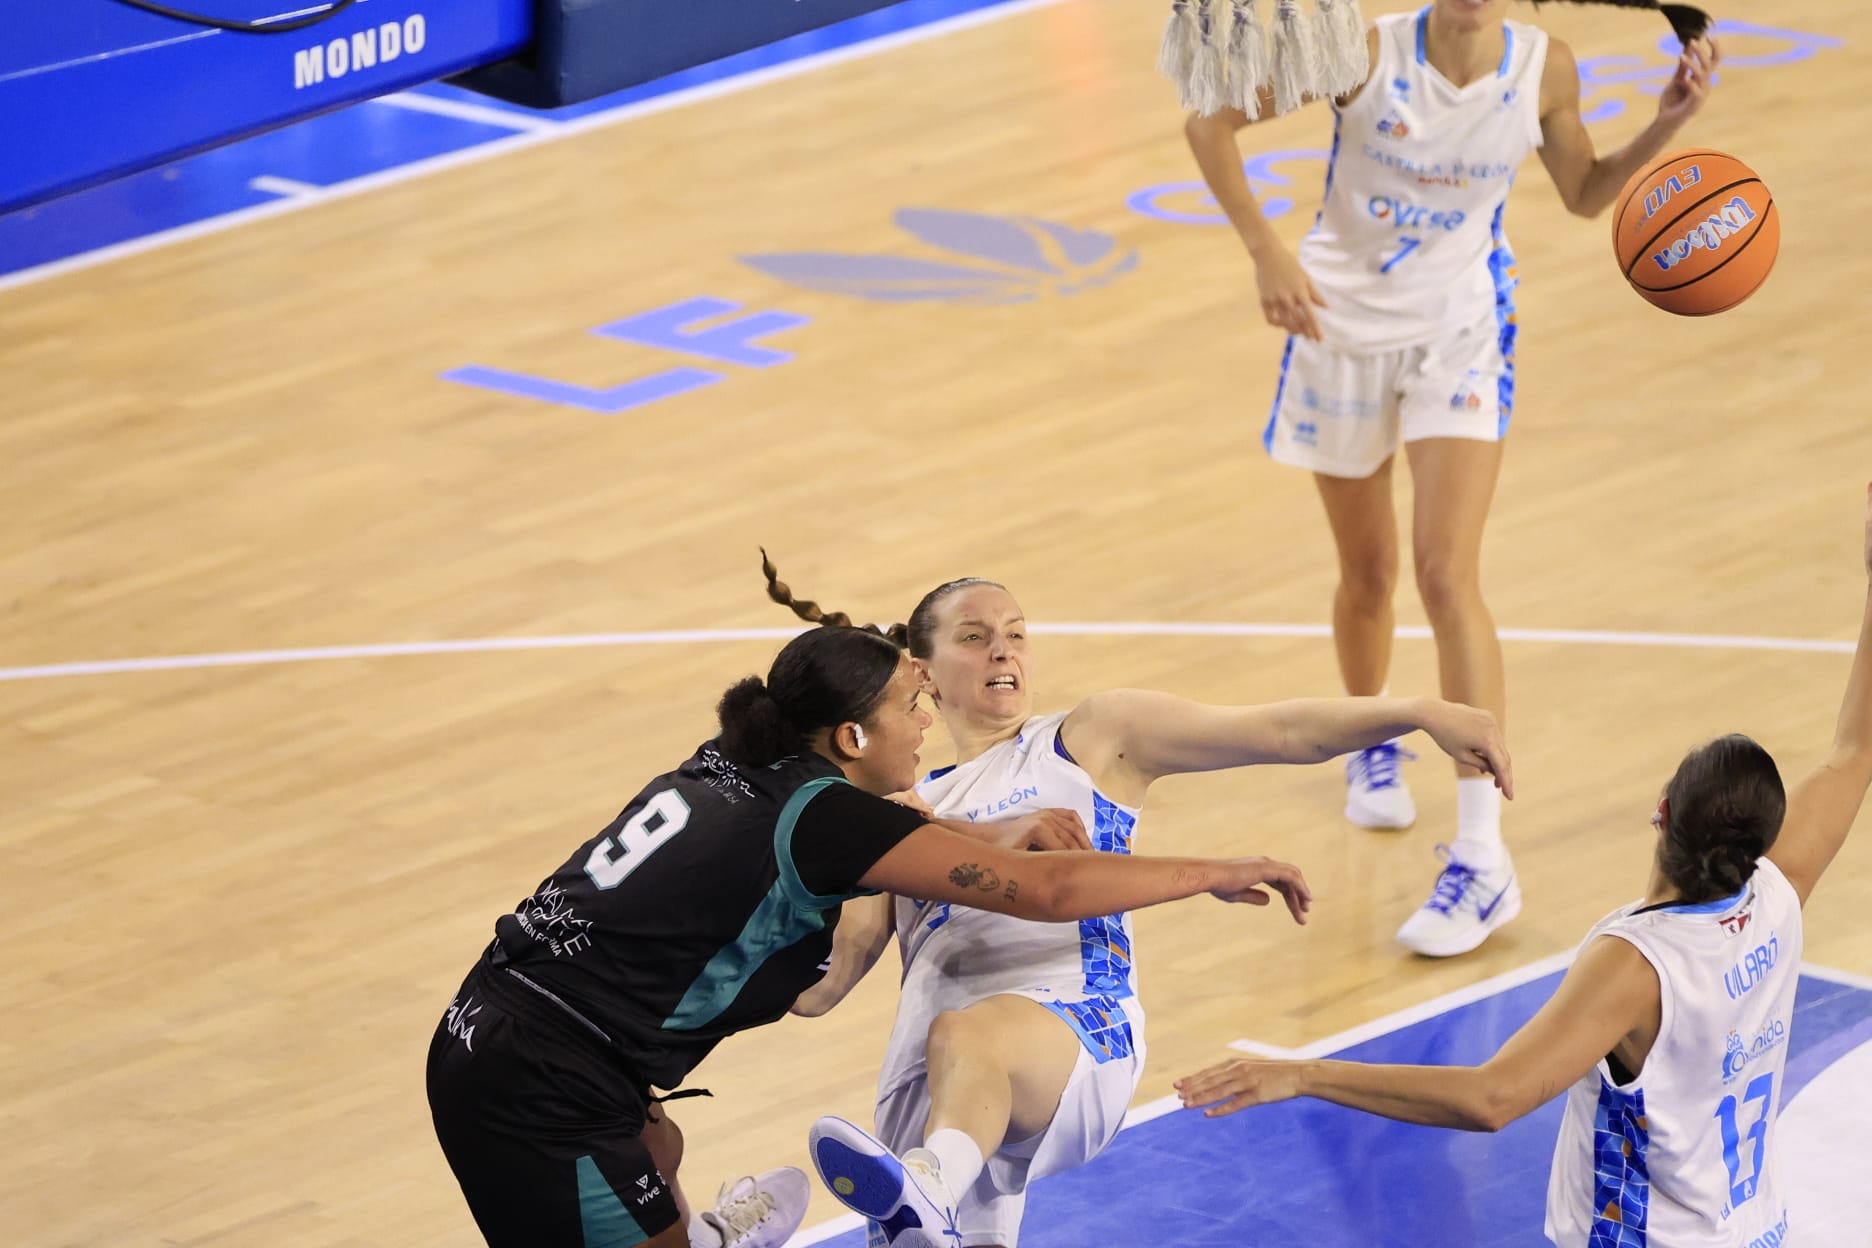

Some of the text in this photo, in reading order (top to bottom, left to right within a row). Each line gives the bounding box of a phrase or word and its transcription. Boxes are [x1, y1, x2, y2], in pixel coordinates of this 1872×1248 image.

[294, 14, 426, 89] MONDO
[1380, 236, 1422, 275] 7
[1653, 196, 1757, 271] Wilson
[436, 295, 813, 414] LF
[583, 788, 691, 891] 9
[967, 786, 1038, 823] Y LEÓN
[1724, 931, 1778, 1000] VILARÓ
[1714, 1071, 1774, 1209] 13
